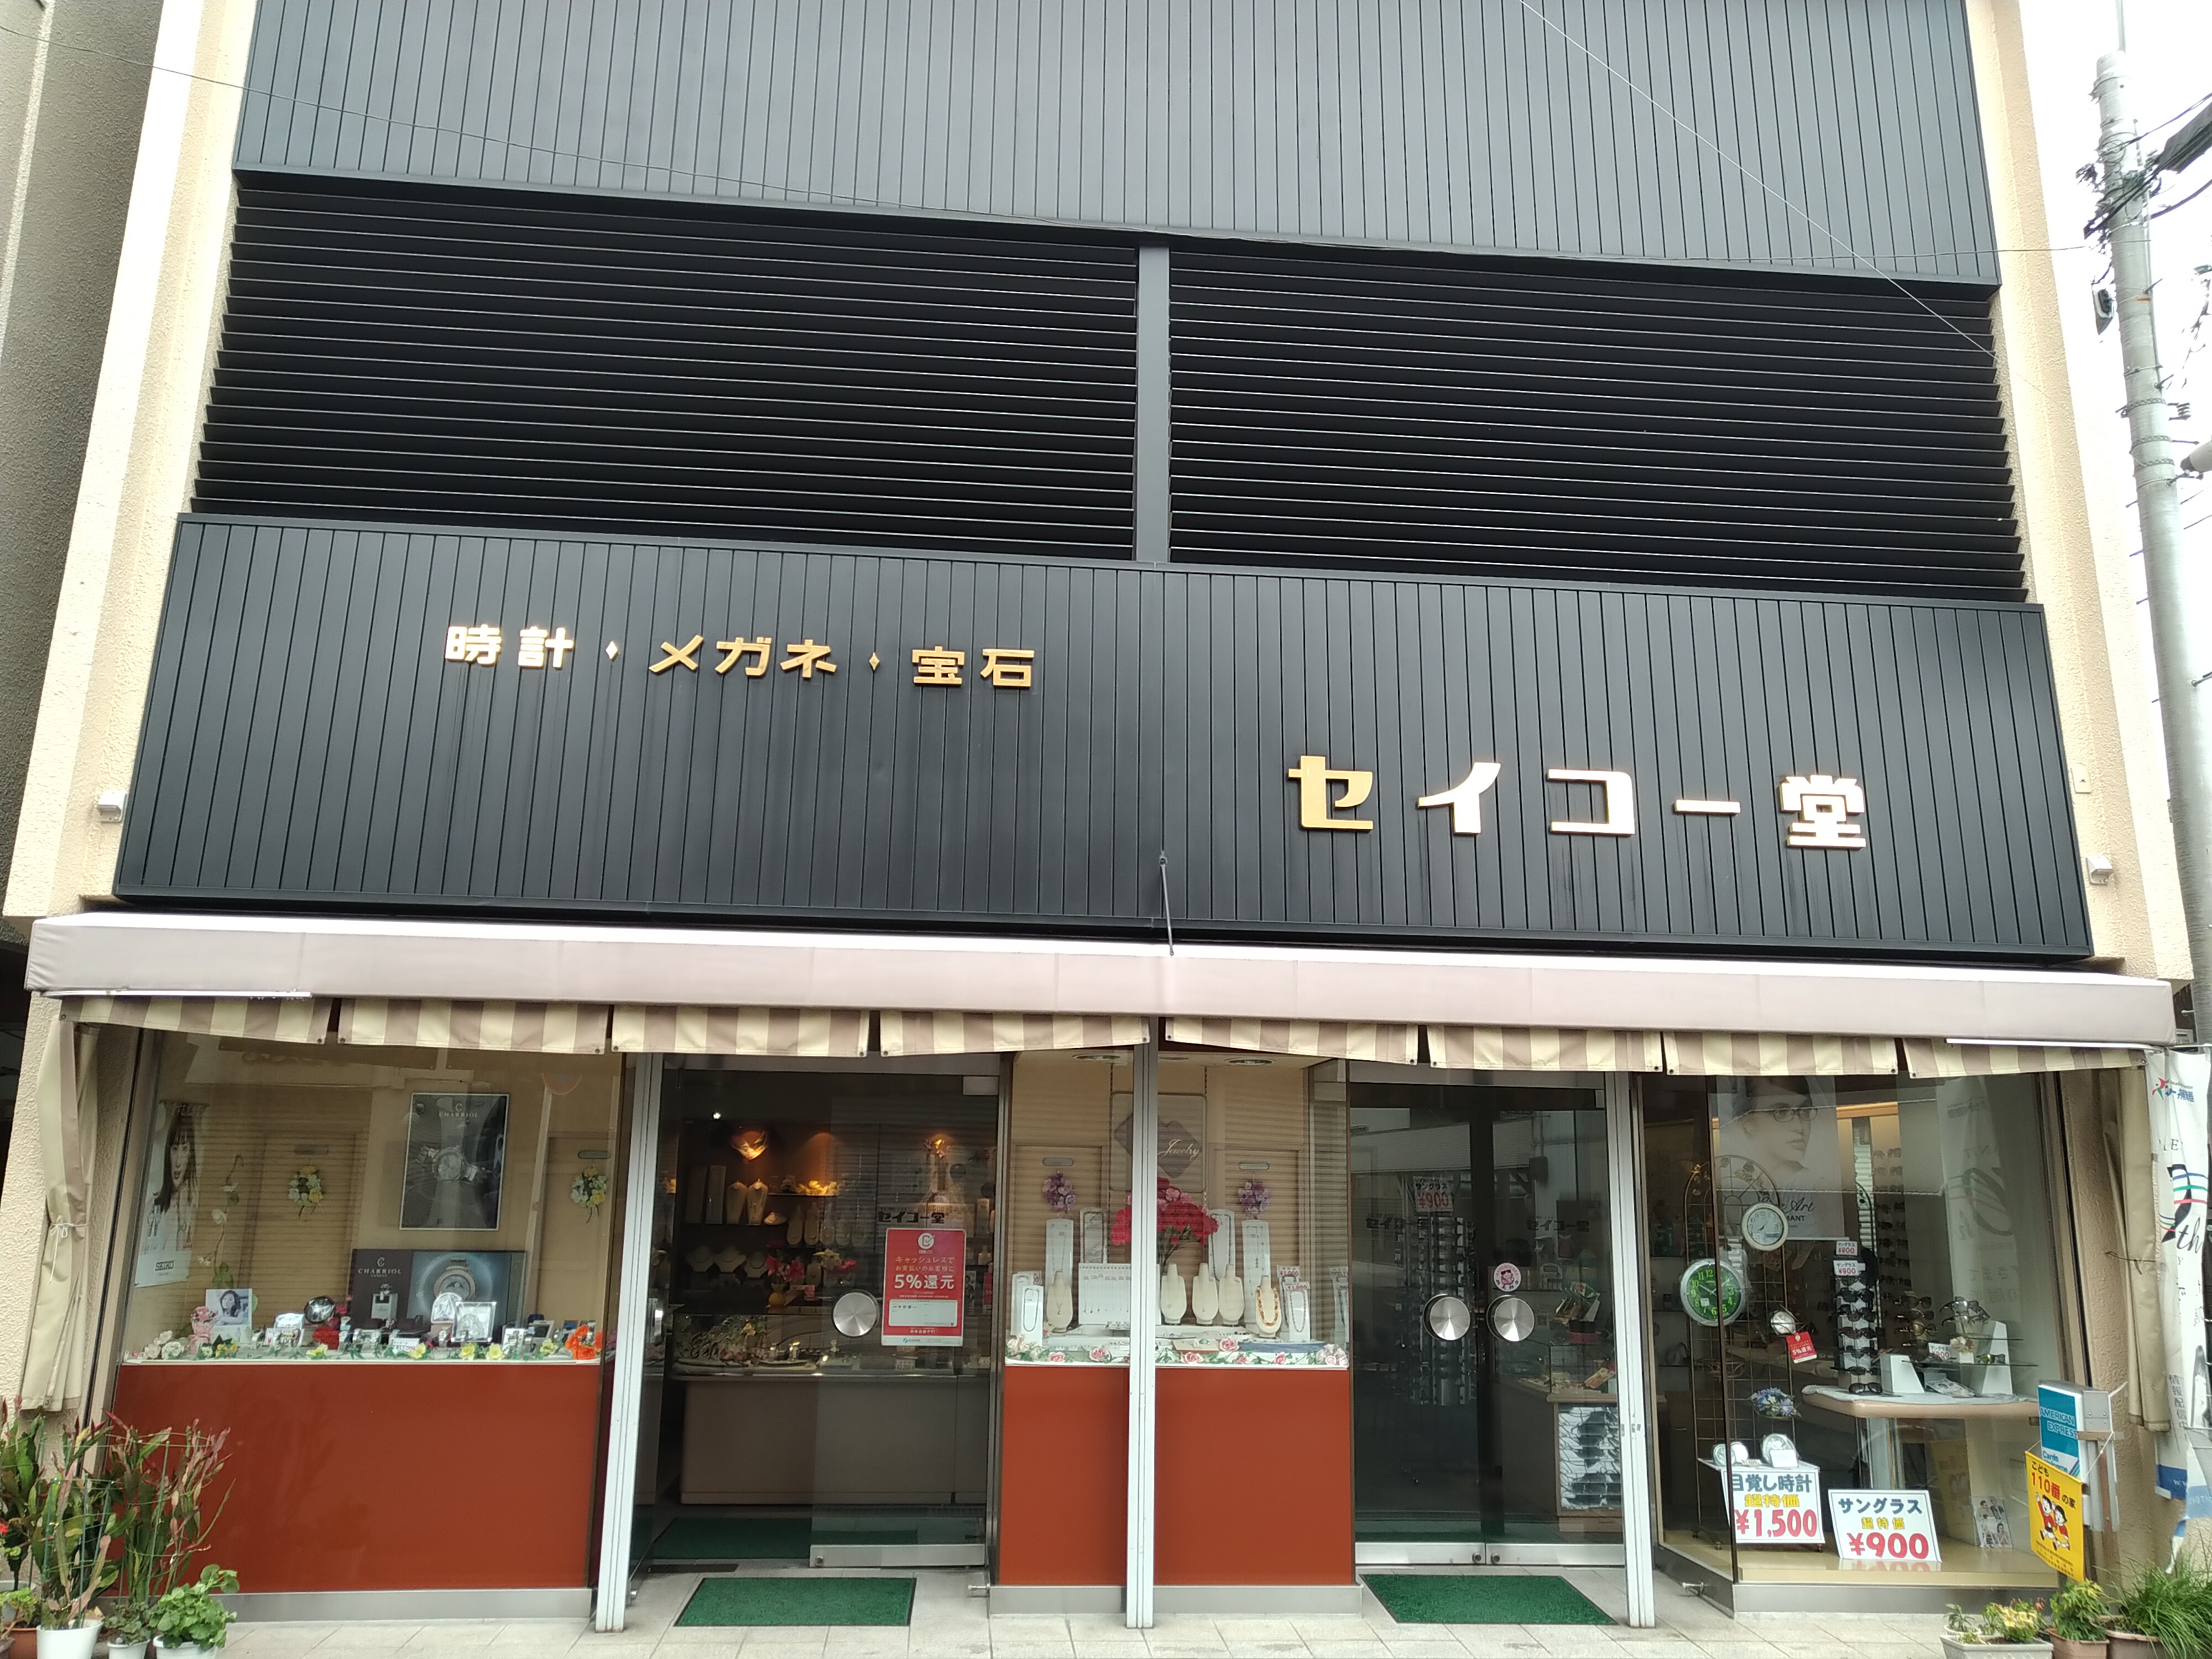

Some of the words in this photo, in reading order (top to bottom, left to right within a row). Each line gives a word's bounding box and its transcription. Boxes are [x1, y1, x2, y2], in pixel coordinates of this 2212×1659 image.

[1288, 755, 1866, 848] セイコー堂
[1418, 1191, 1449, 1209] ¥900
[878, 1211, 945, 1224] セイコー堂
[155, 1260, 175, 1271] SEIKO
[894, 1274, 954, 1289] 5%還元
[2039, 1406, 2075, 1426] AMERICAN
[2042, 1451, 2059, 1462] Cards
[2032, 1461, 2049, 1477] こども
[1732, 1474, 1812, 1493] 目覚し時計
[1744, 1494, 1800, 1508] 超特価
[1838, 1497, 1923, 1515] サングラス
[1735, 1509, 1818, 1537] ¥1,500
[1861, 1517, 1906, 1530] 超特価
[1846, 1532, 1929, 1559] ¥900
